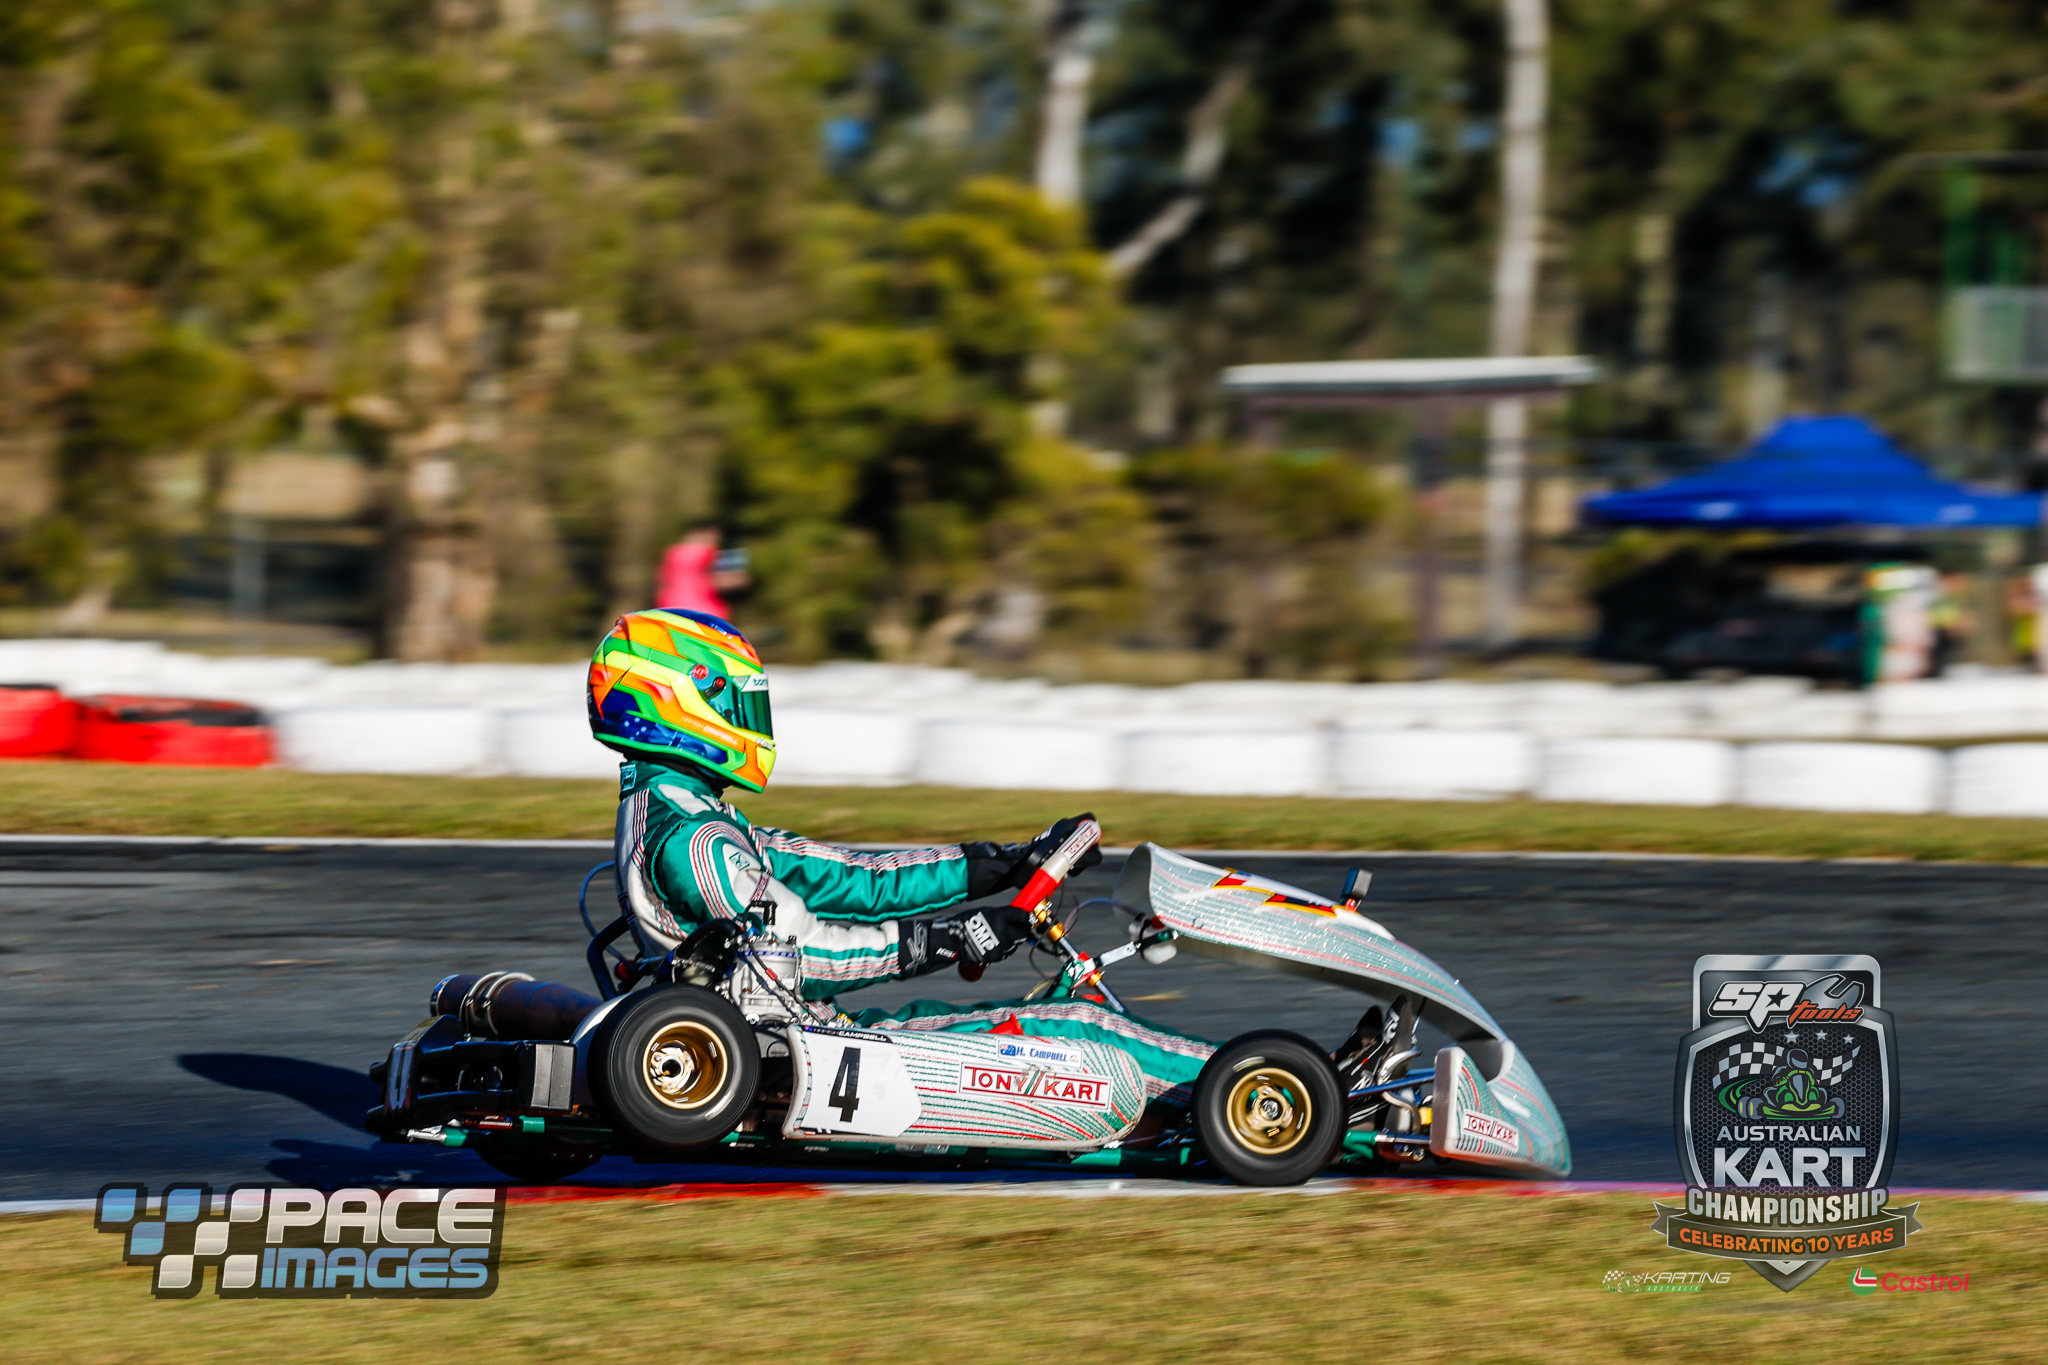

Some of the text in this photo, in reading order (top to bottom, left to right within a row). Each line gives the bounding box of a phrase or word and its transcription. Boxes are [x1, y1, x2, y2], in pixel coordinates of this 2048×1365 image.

[965, 912, 1000, 956] OMP
[838, 1030, 888, 1042] CAMPBELL
[828, 1046, 862, 1123] 4
[966, 1065, 1106, 1102] TONY KART
[1466, 1114, 1491, 1135] TONY
